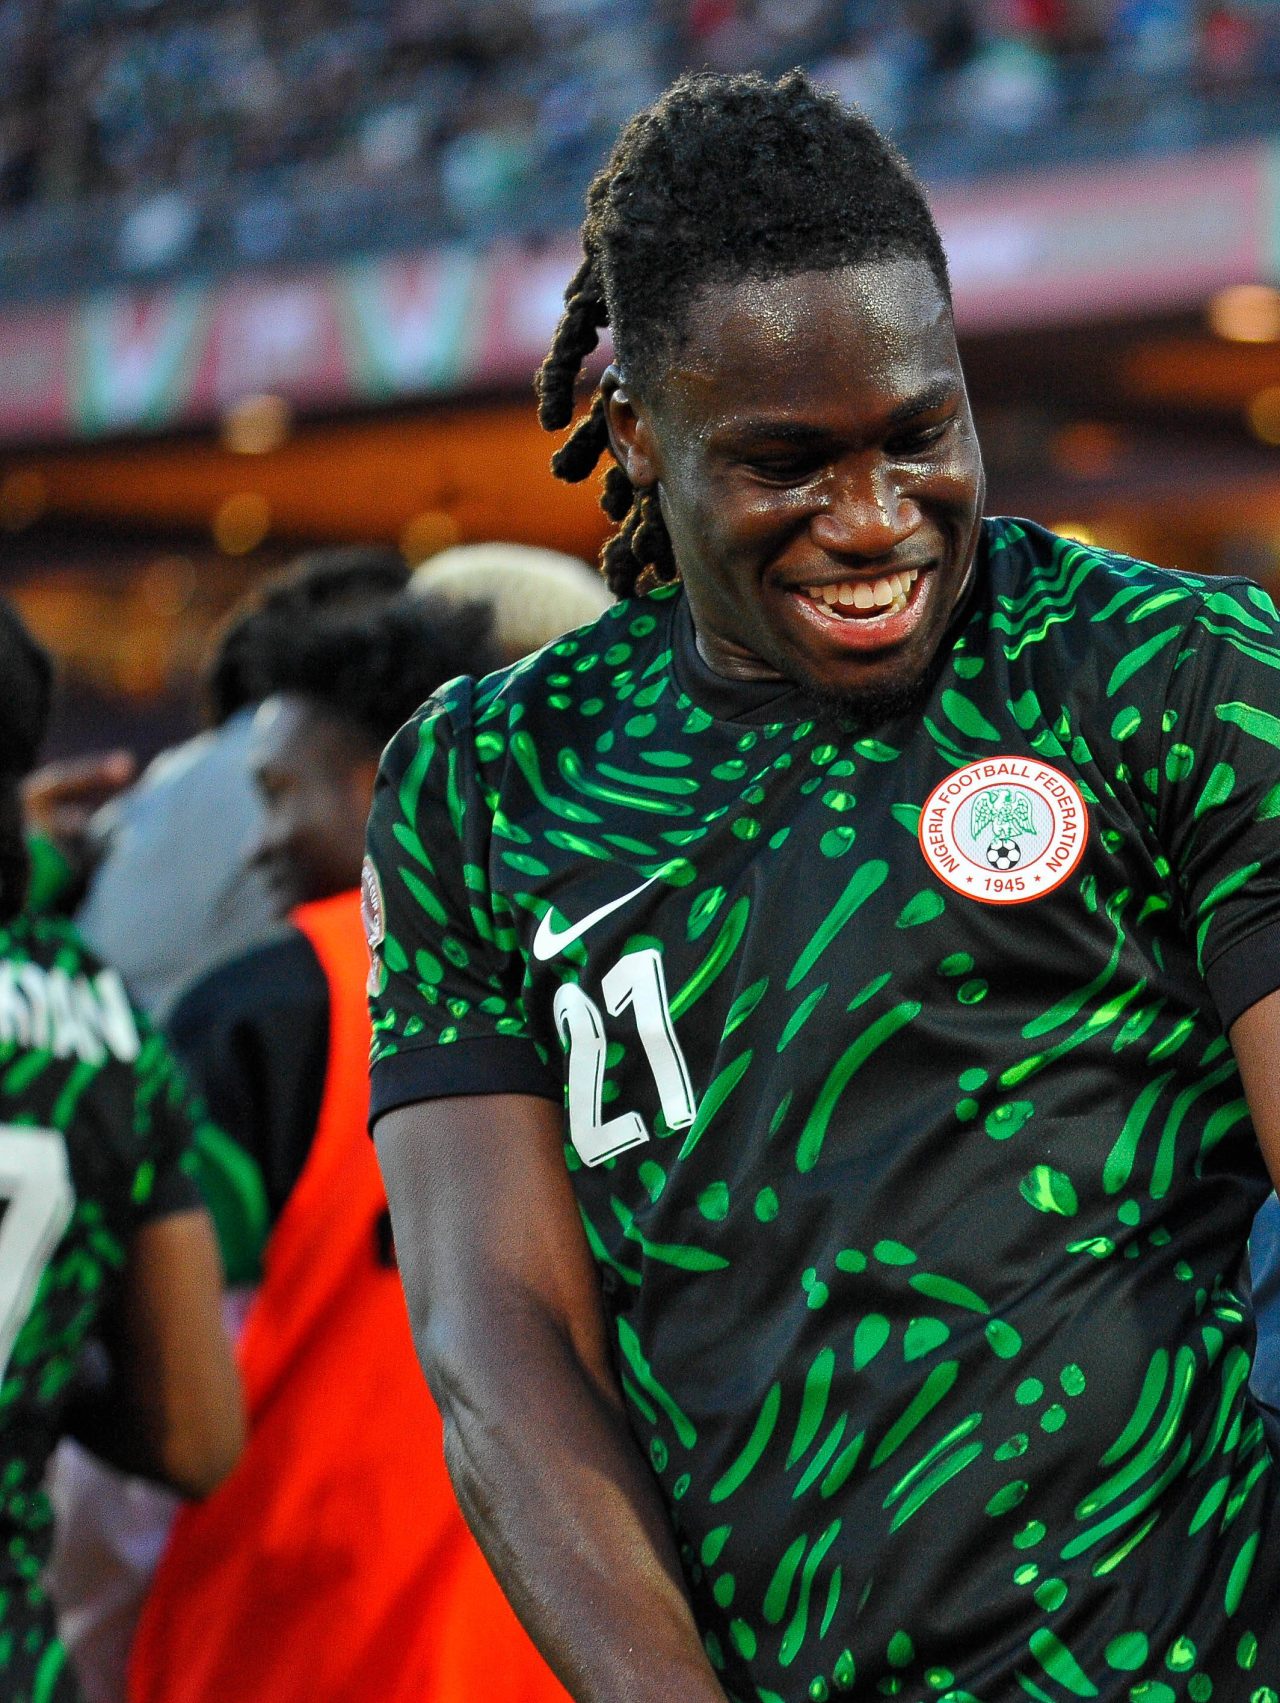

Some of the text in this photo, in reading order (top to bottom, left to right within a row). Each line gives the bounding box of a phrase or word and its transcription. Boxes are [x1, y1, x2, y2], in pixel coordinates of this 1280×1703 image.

[928, 763, 1077, 873] NIGERIA FOOTBALL FEDERATION
[984, 877, 1026, 893] 1945
[553, 949, 697, 1168] 21
